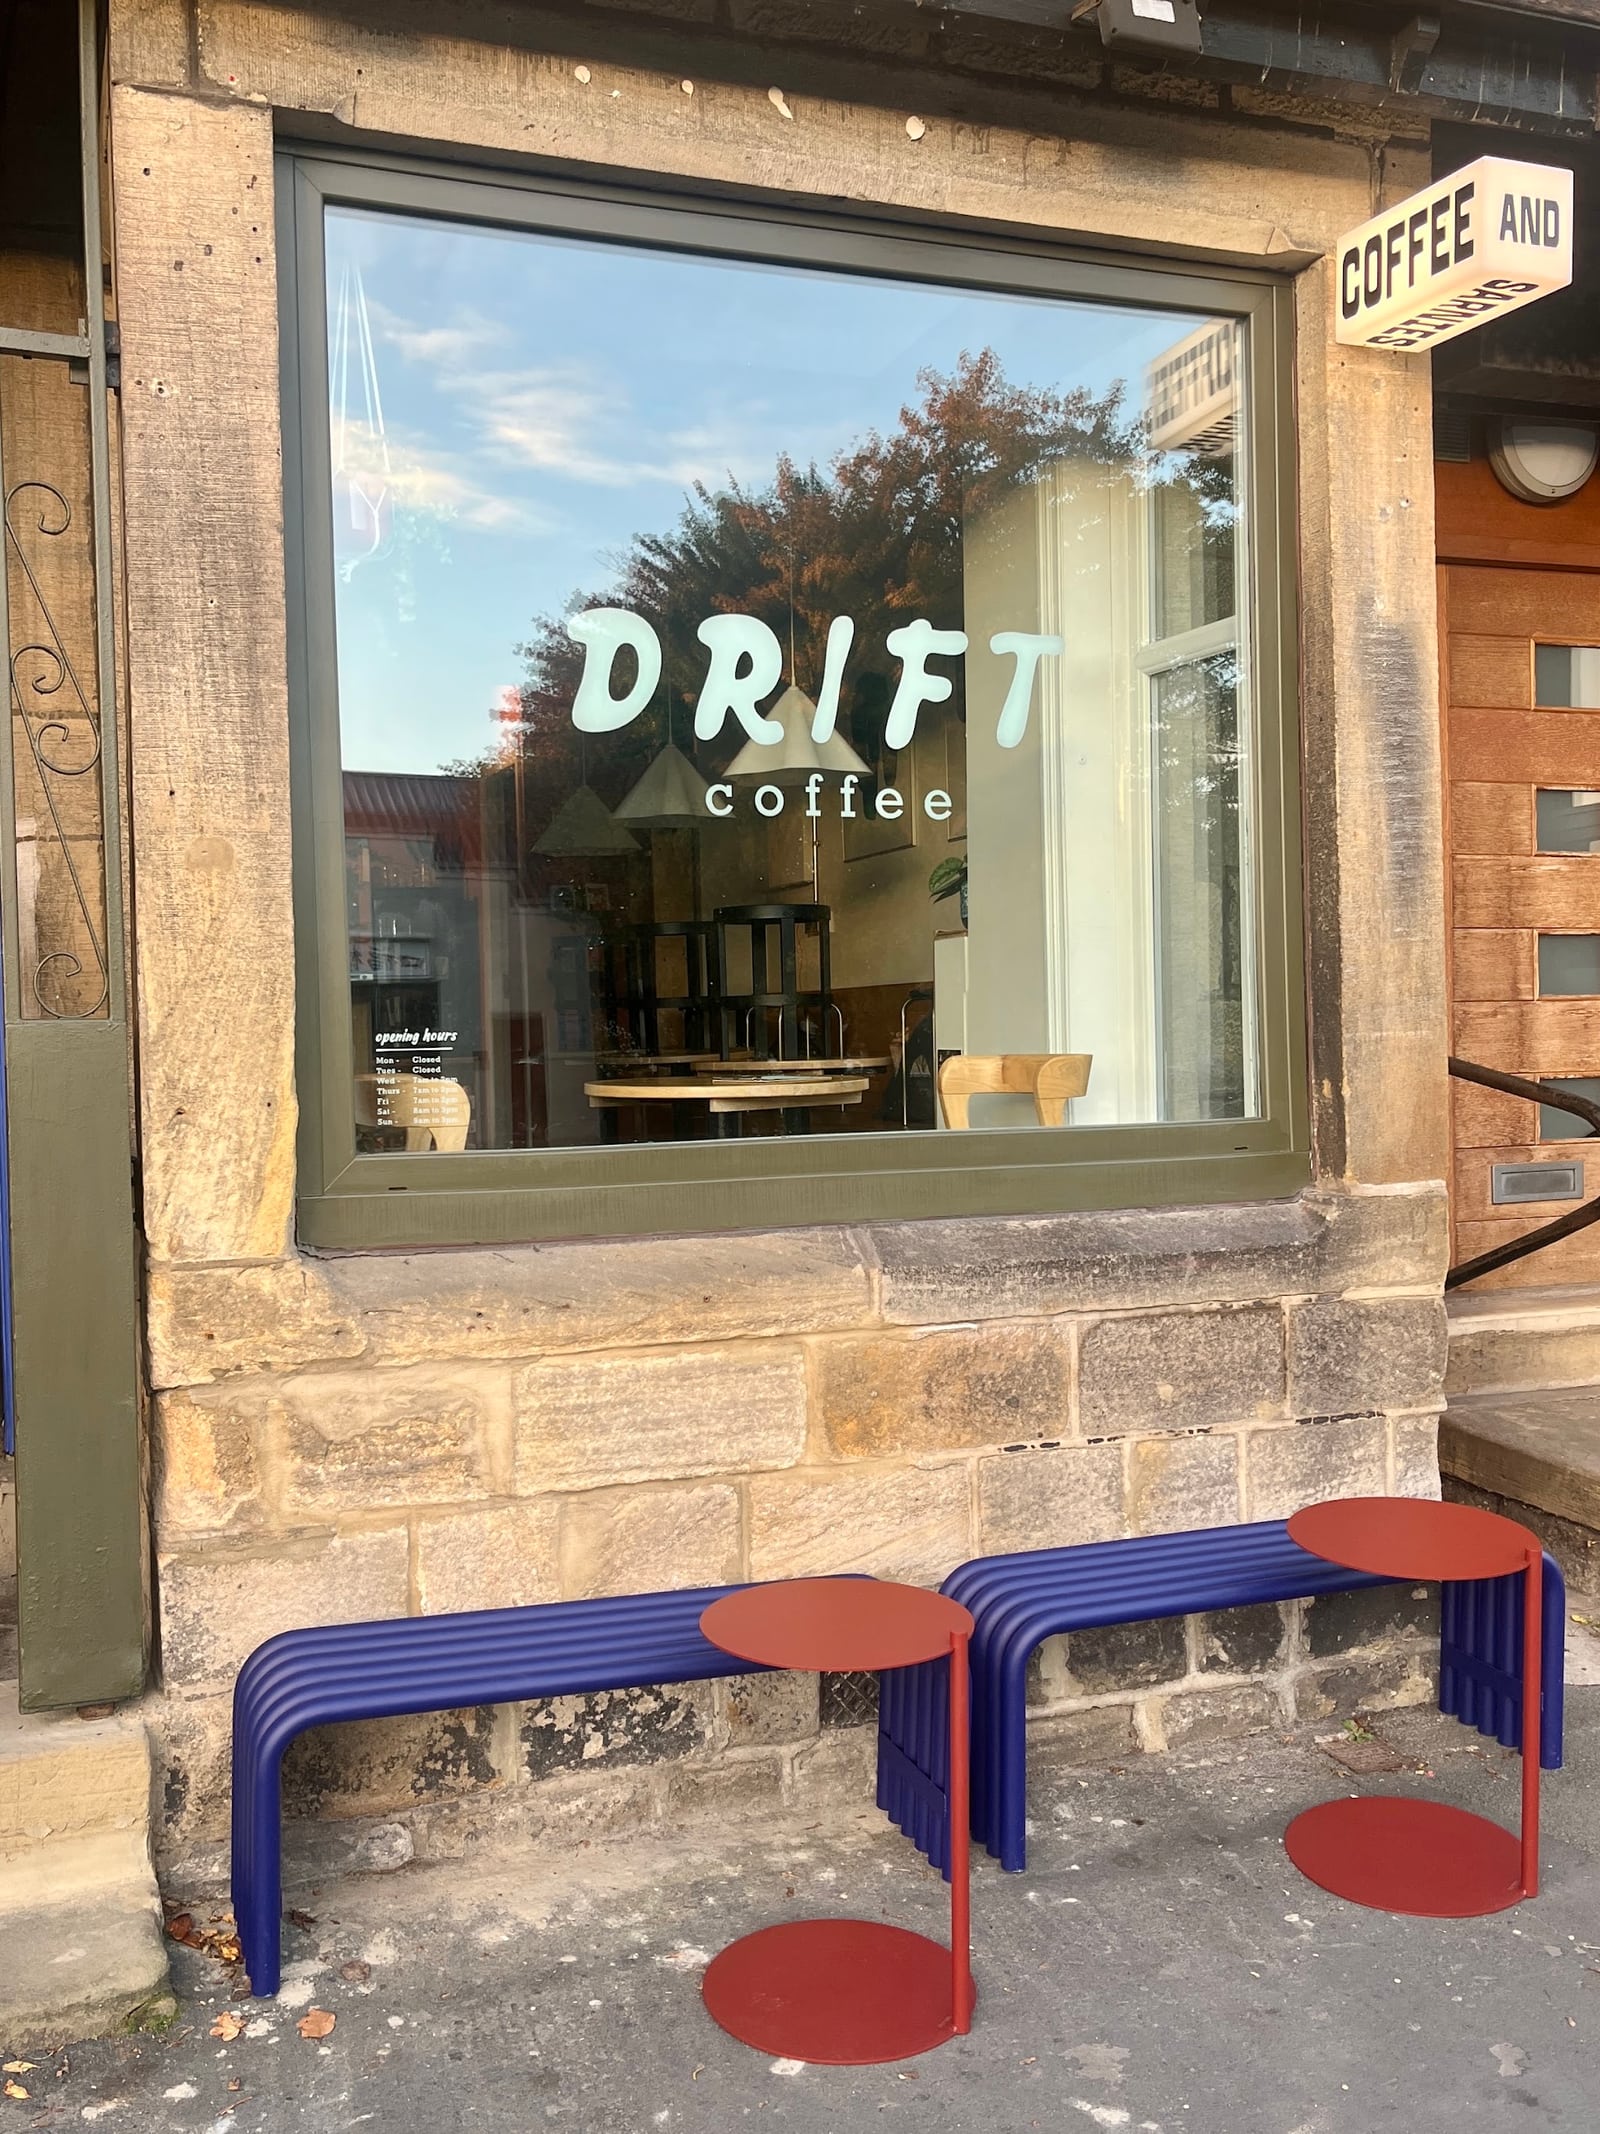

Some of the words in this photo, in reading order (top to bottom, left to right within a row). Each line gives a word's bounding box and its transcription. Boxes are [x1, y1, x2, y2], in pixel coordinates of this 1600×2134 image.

[1500, 193, 1560, 248] AND
[1342, 181, 1475, 320] COFFEE
[1366, 279, 1539, 347] SARNIES
[567, 607, 1066, 750] DRIFT
[704, 773, 953, 821] coffee
[375, 1028, 420, 1046] opening
[422, 1027, 458, 1043] hours
[375, 1056, 395, 1064] Mon
[412, 1056, 441, 1064] Closed
[412, 1066, 441, 1074] Closed
[376, 1077, 396, 1085] Wed
[376, 1087, 400, 1095] Thurs
[377, 1118, 393, 1126] Sun
